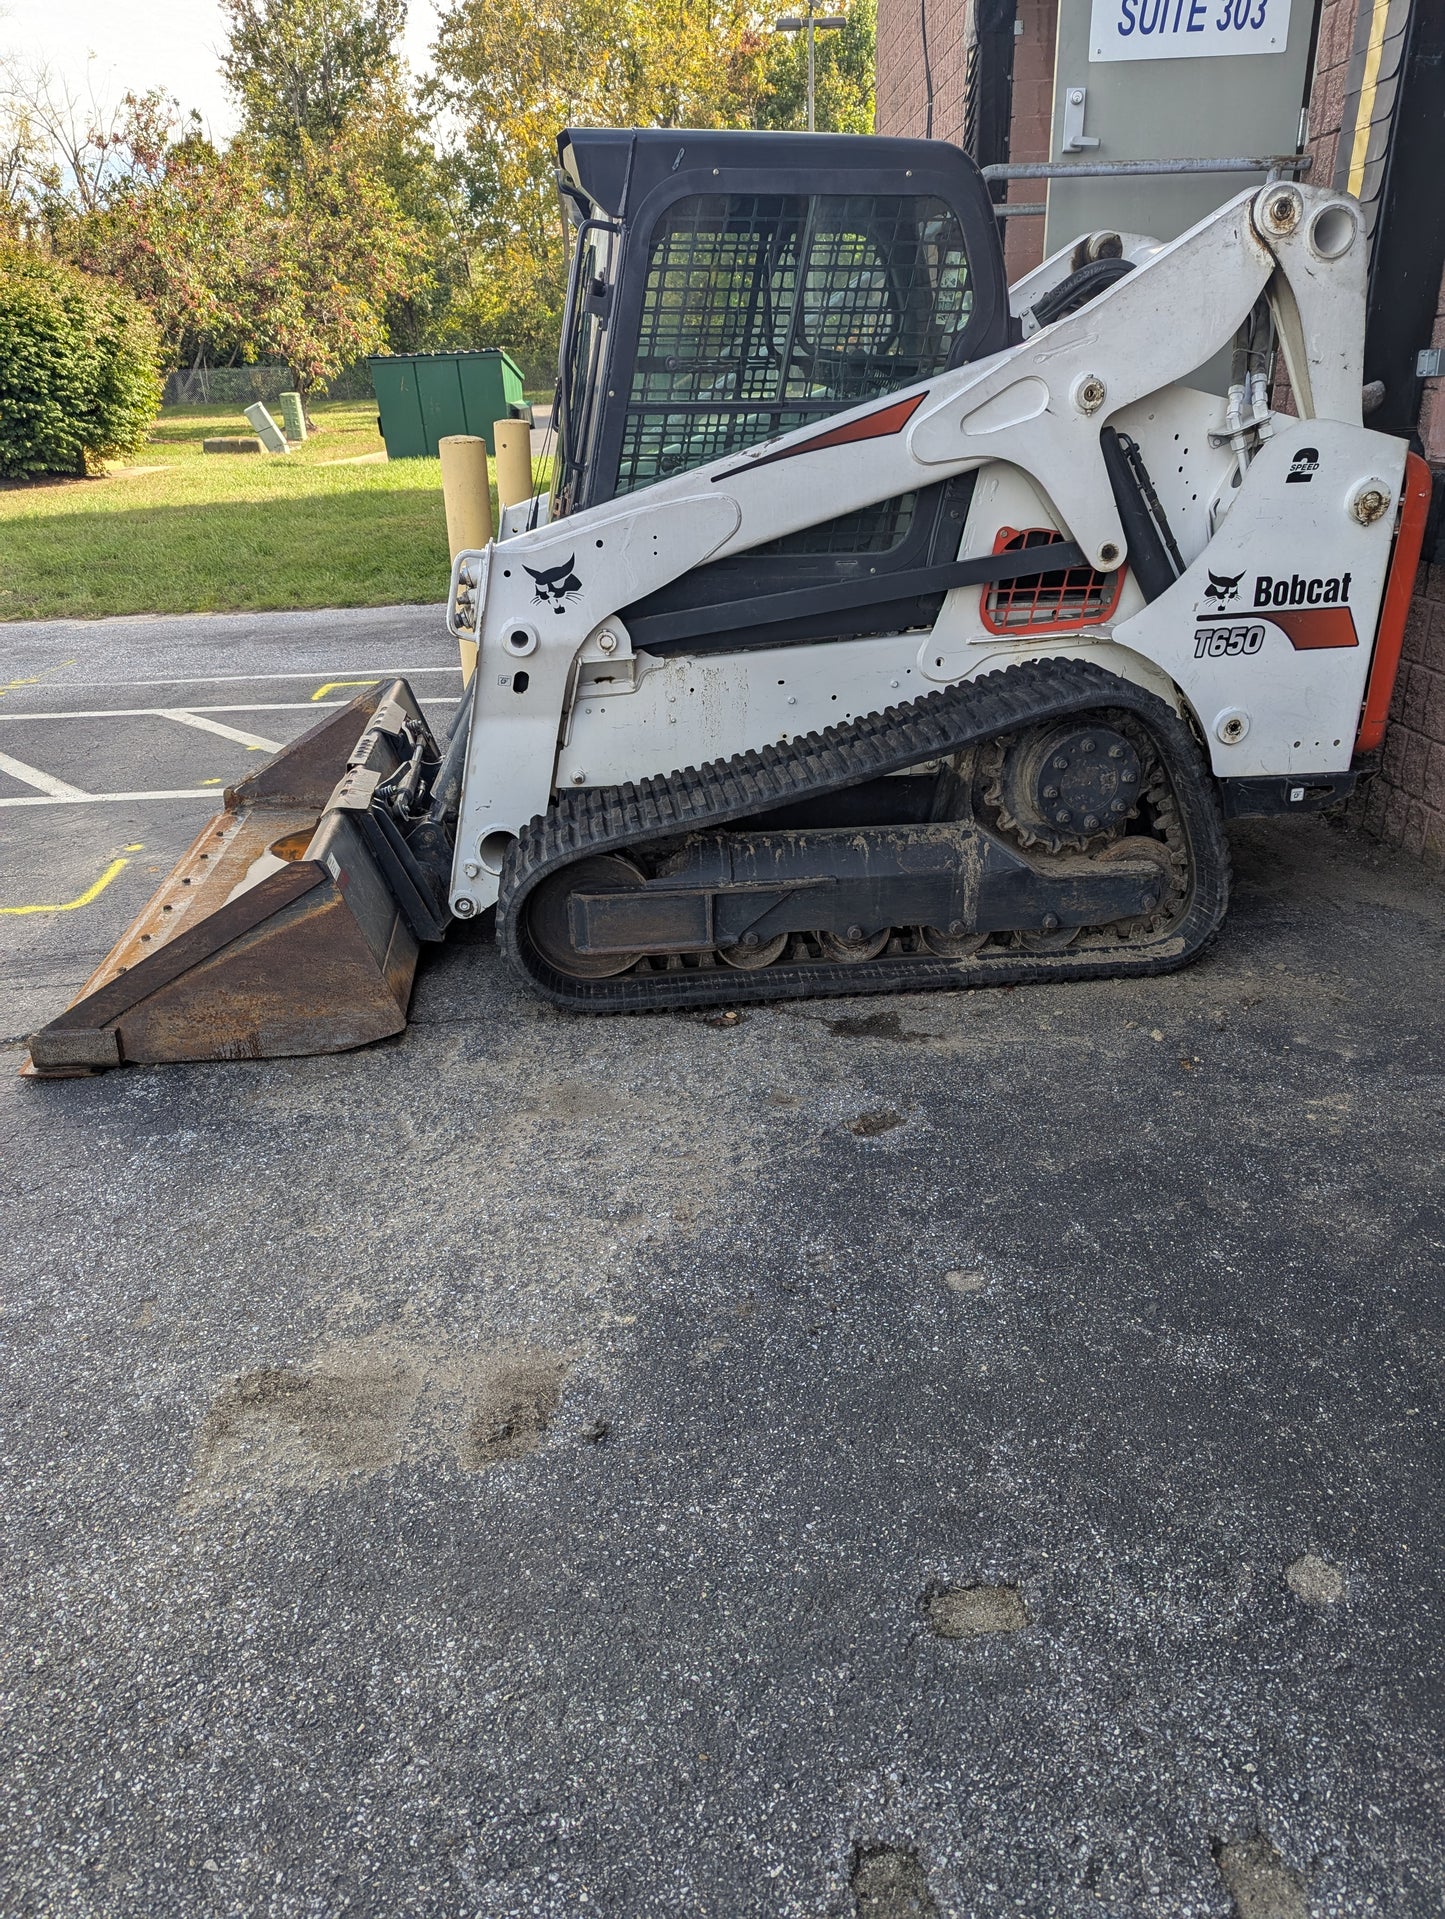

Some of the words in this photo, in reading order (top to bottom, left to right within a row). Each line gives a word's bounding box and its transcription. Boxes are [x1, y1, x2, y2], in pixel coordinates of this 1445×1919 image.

[1118, 0, 1207, 36] SUITE
[1216, 0, 1268, 31] 303
[1286, 447, 1319, 483] 2
[1290, 463, 1320, 471] SPEED
[1253, 573, 1352, 607] Bobcat
[1194, 625, 1265, 658] T650
